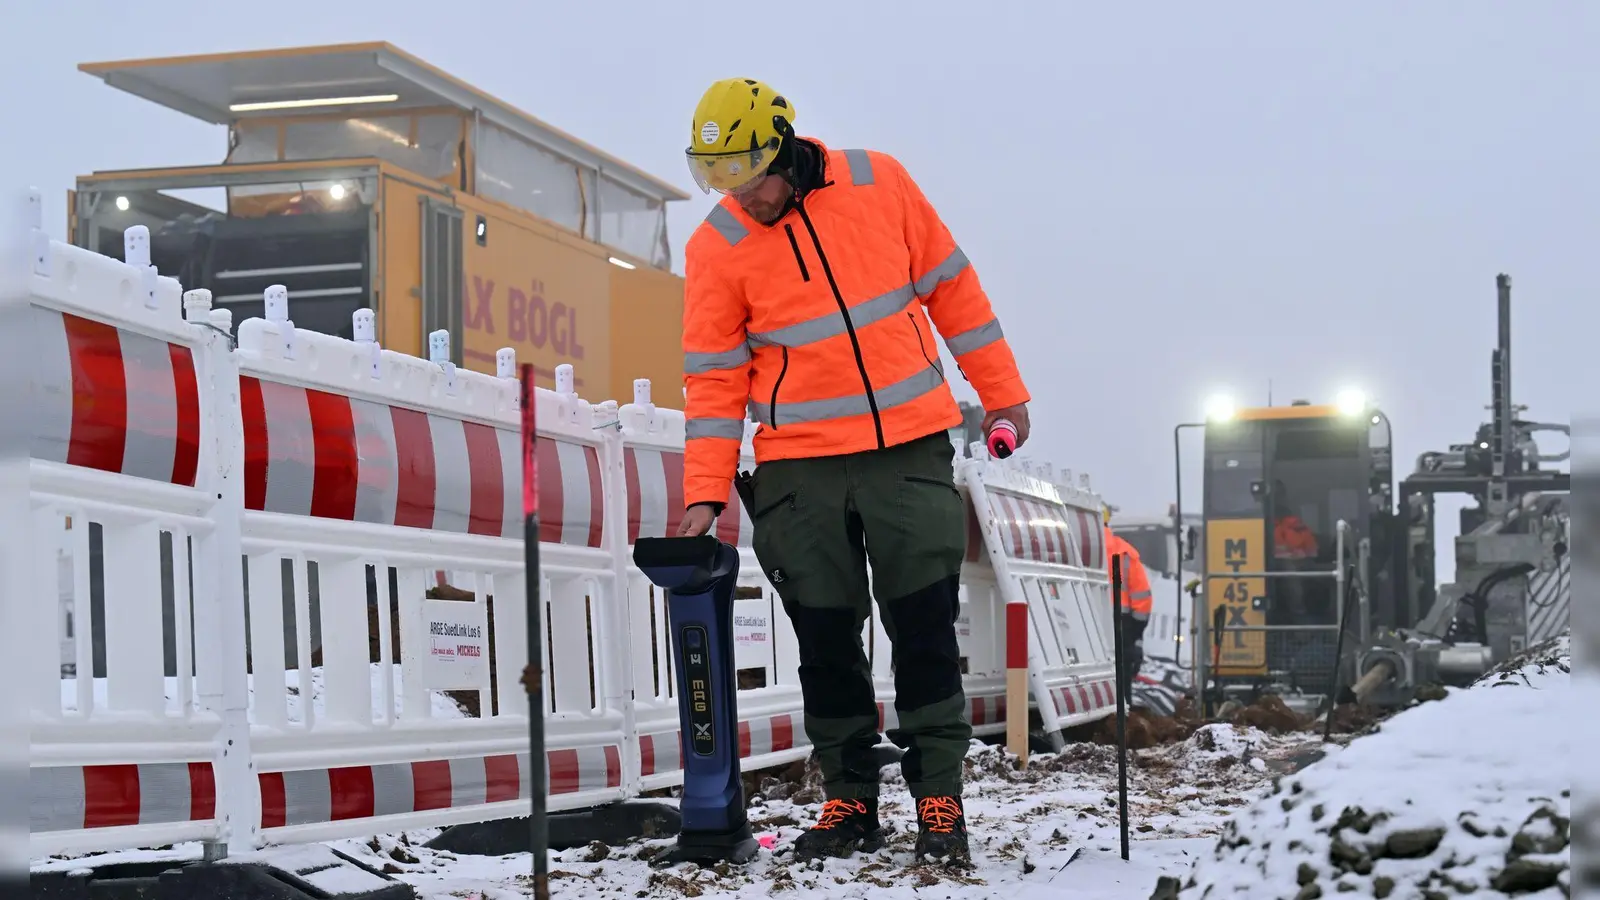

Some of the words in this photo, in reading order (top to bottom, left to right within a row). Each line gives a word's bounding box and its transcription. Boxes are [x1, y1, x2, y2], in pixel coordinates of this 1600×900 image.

[508, 278, 584, 360] BÖGL
[430, 621, 443, 635] ARGE
[468, 625, 477, 638] Los
[457, 644, 481, 657] MICHELS
[694, 722, 711, 736] X
